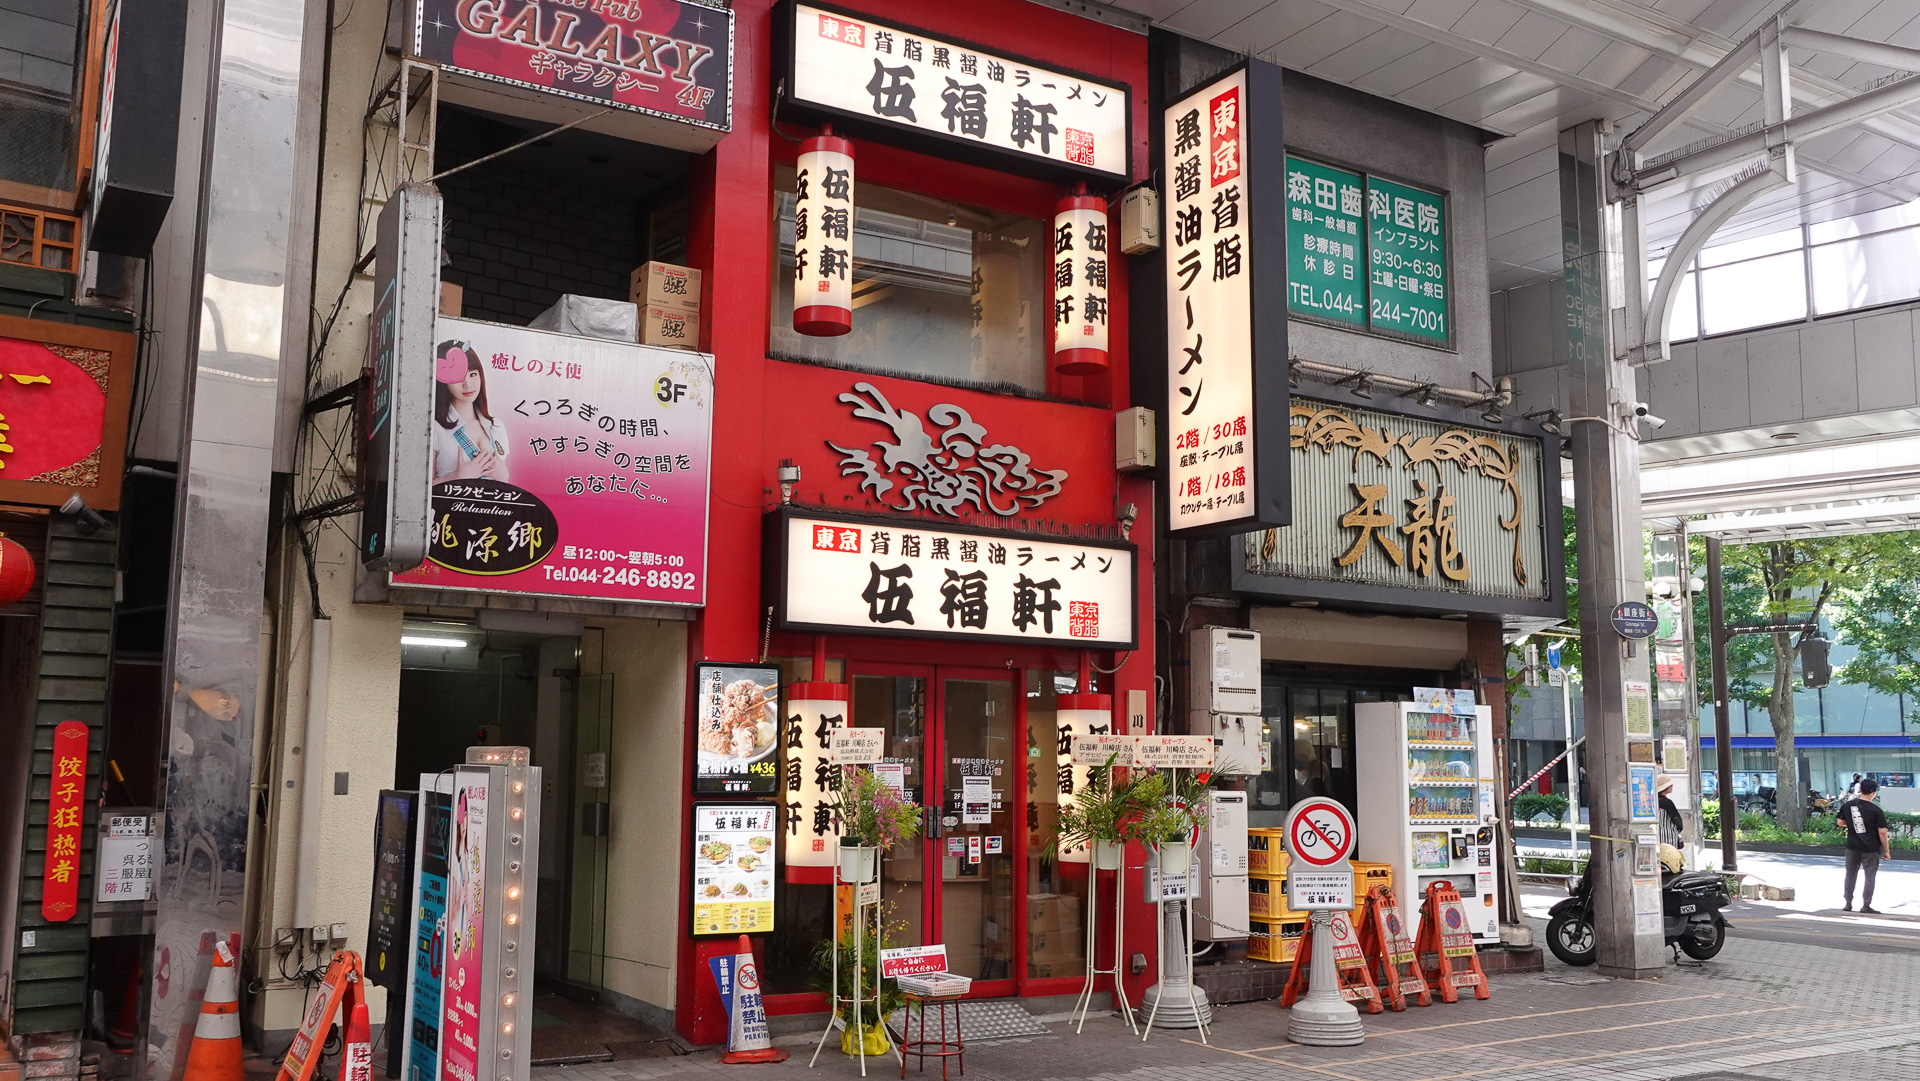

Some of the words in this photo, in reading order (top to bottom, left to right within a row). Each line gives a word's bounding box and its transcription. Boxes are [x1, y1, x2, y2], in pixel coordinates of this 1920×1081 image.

[593, 0, 641, 21] Pub
[456, 0, 712, 81] GALAXY
[530, 51, 658, 95] ギャラクシー
[821, 17, 862, 46] 東京
[874, 30, 1107, 108] 背脂黒醤油ラーメン
[675, 83, 714, 110] 4F
[865, 57, 1059, 154] 伍福軒
[1213, 97, 1237, 180] 東京
[1288, 171, 1439, 236] 森田歯科医院
[817, 166, 850, 281] 伍福軒
[1211, 184, 1242, 283] 背脂
[1303, 234, 1354, 261] 診療時間
[1374, 227, 1440, 254] インプラント
[1084, 221, 1107, 326] 伍福軒
[1174, 108, 1203, 416] 黒醤油ラーメン
[663, 285, 687, 295] クリーナー
[664, 275, 688, 287] パイプ
[1290, 282, 1363, 315] TEL.044-
[1372, 299, 1444, 333] 244-7001
[662, 319, 685, 330] パイプ
[662, 328, 685, 338] クリーナー
[491, 352, 582, 381] 癒しの天使
[656, 376, 687, 404] 3F
[513, 398, 670, 438] くつろぎの時間、
[529, 435, 692, 474] やすらぎの空間を
[443, 484, 521, 501] リラクゼーション
[450, 501, 514, 516] Relaxation
[368, 531, 378, 555] 4F
[1333, 479, 1470, 581] 天龍
[815, 527, 859, 552] 東京
[870, 531, 1113, 574] 背脂黒醤油ラーメン
[543, 564, 695, 591] Tel.044-246-8892
[861, 561, 1062, 634] 伍福軒
[1623, 607, 1646, 618] 銀座街
[711, 670, 722, 730] 店舗仕込み
[1079, 743, 1099, 752] 伍福軒
[1102, 743, 1122, 752] 川崎店
[1098, 736, 1123, 744] 祝オープン
[1141, 745, 1162, 754] 伍福軒
[1166, 745, 1186, 753] 川崎店
[1187, 746, 1206, 754] さんへ
[1161, 737, 1187, 745] 祝オープン
[750, 762, 776, 774] ¥436
[48, 755, 84, 884] 饺子狂热者
[112, 817, 143, 828] 郵便受
[715, 817, 758, 829] 伍福軒
[133, 842, 149, 880] つる屋
[1249, 853, 1268, 866] RIN
[104, 868, 118, 895] 三階
[120, 854, 135, 894] 呉服店
[1250, 895, 1269, 908] RIN
[1307, 895, 1336, 904] 伍福軒
[1682, 904, 1695, 913] VOX
[903, 957, 925, 965] ご自由に
[719, 957, 731, 995] 駐輪禁止
[742, 1009, 766, 1025] 禁止
